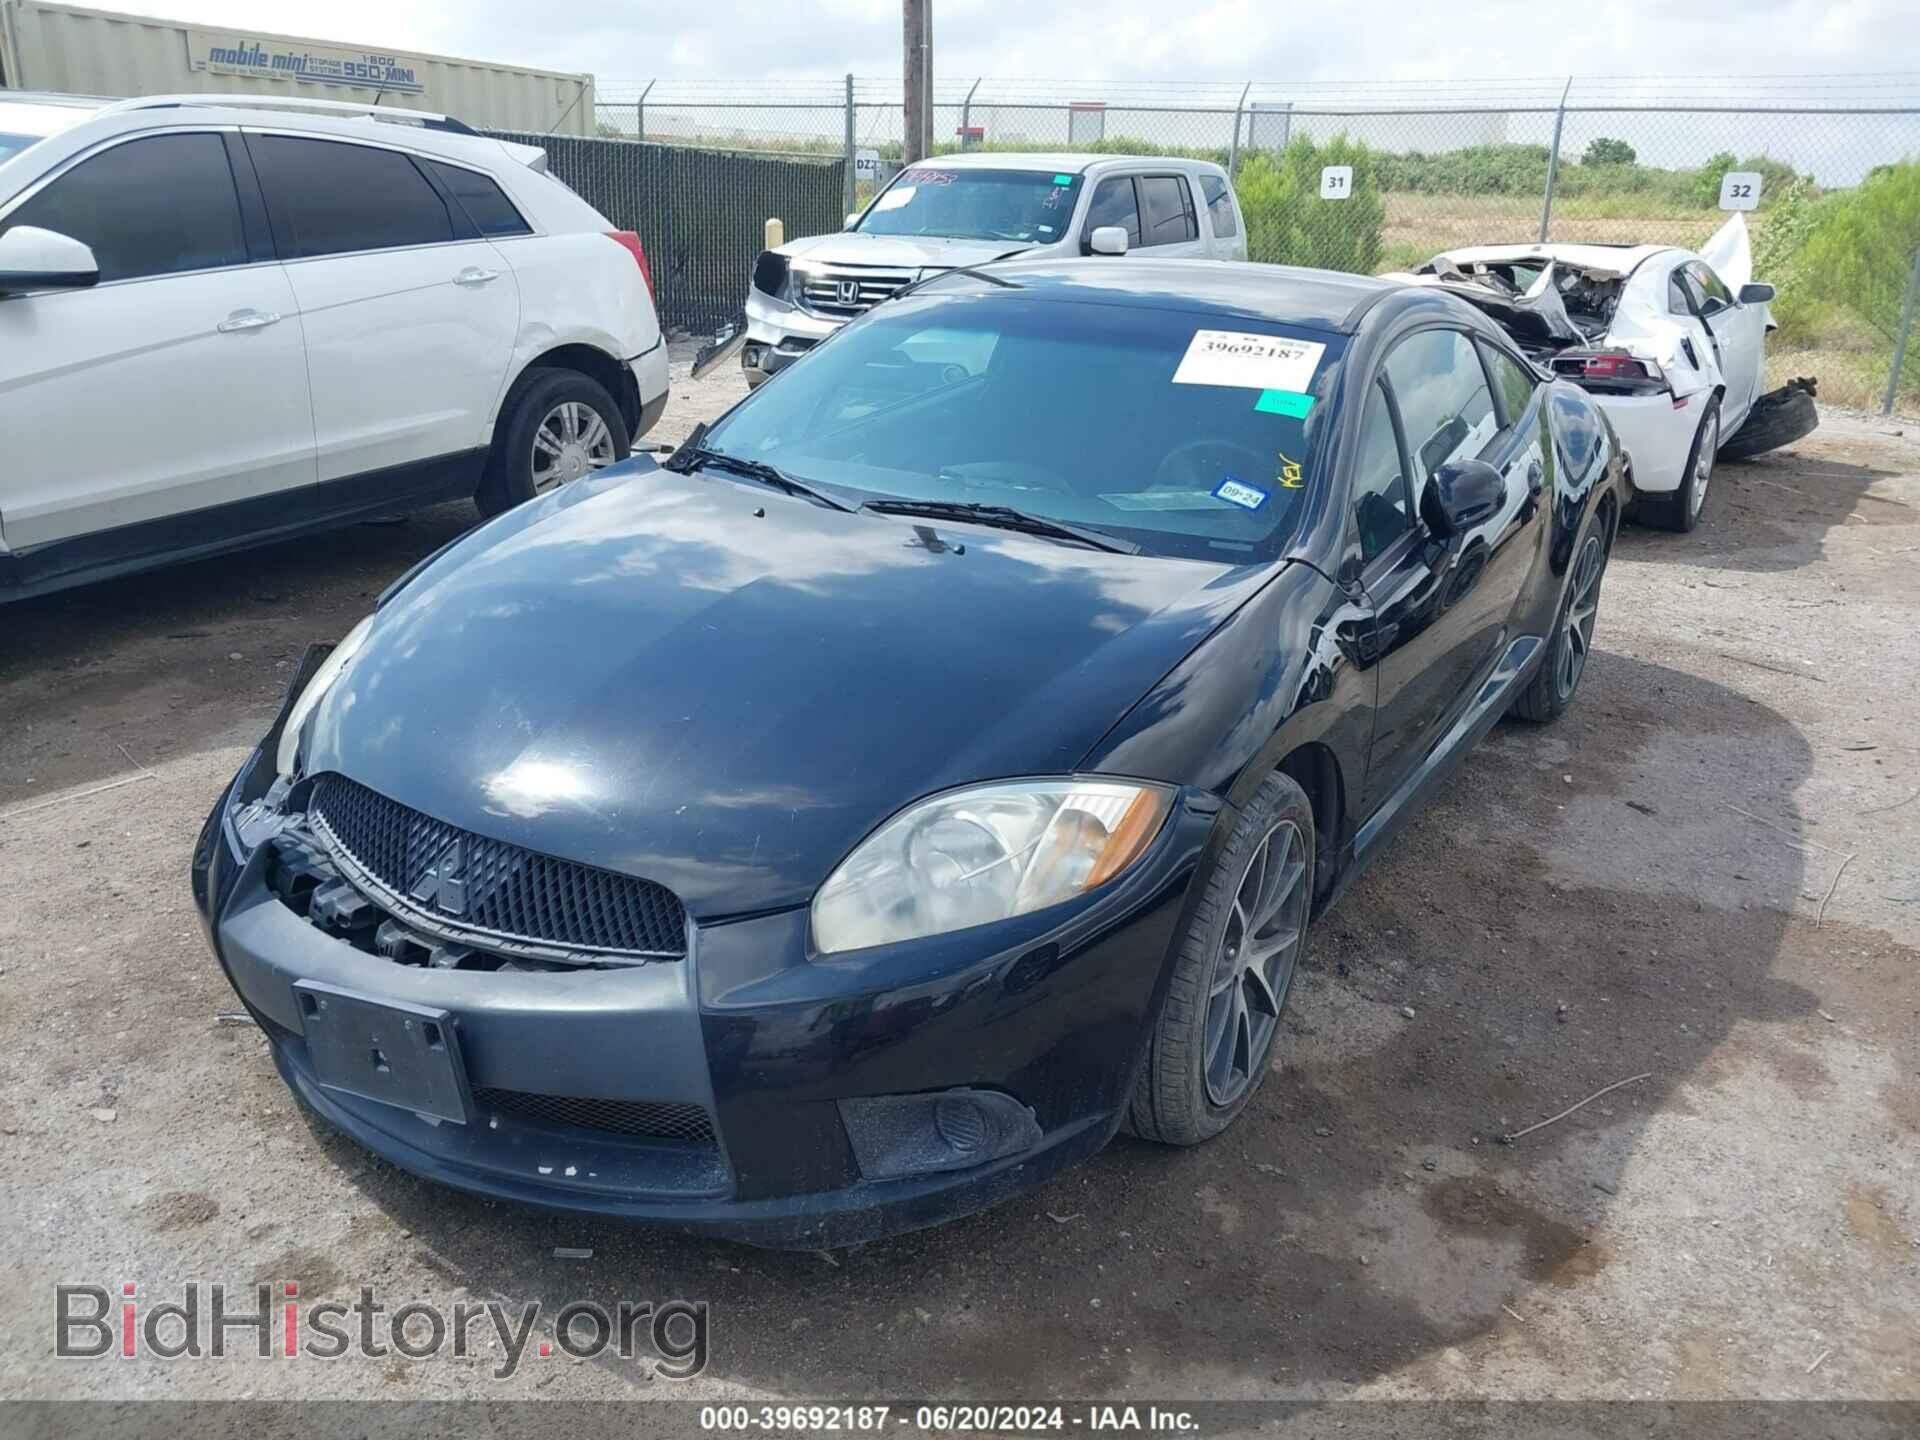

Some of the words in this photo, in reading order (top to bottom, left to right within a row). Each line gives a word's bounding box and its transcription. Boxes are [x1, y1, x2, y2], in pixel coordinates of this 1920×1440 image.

[209, 40, 268, 67] mobile
[271, 52, 308, 72] mini
[1328, 176, 1344, 188] 31
[1730, 184, 1751, 198] 32
[1202, 341, 1305, 360] 39692187
